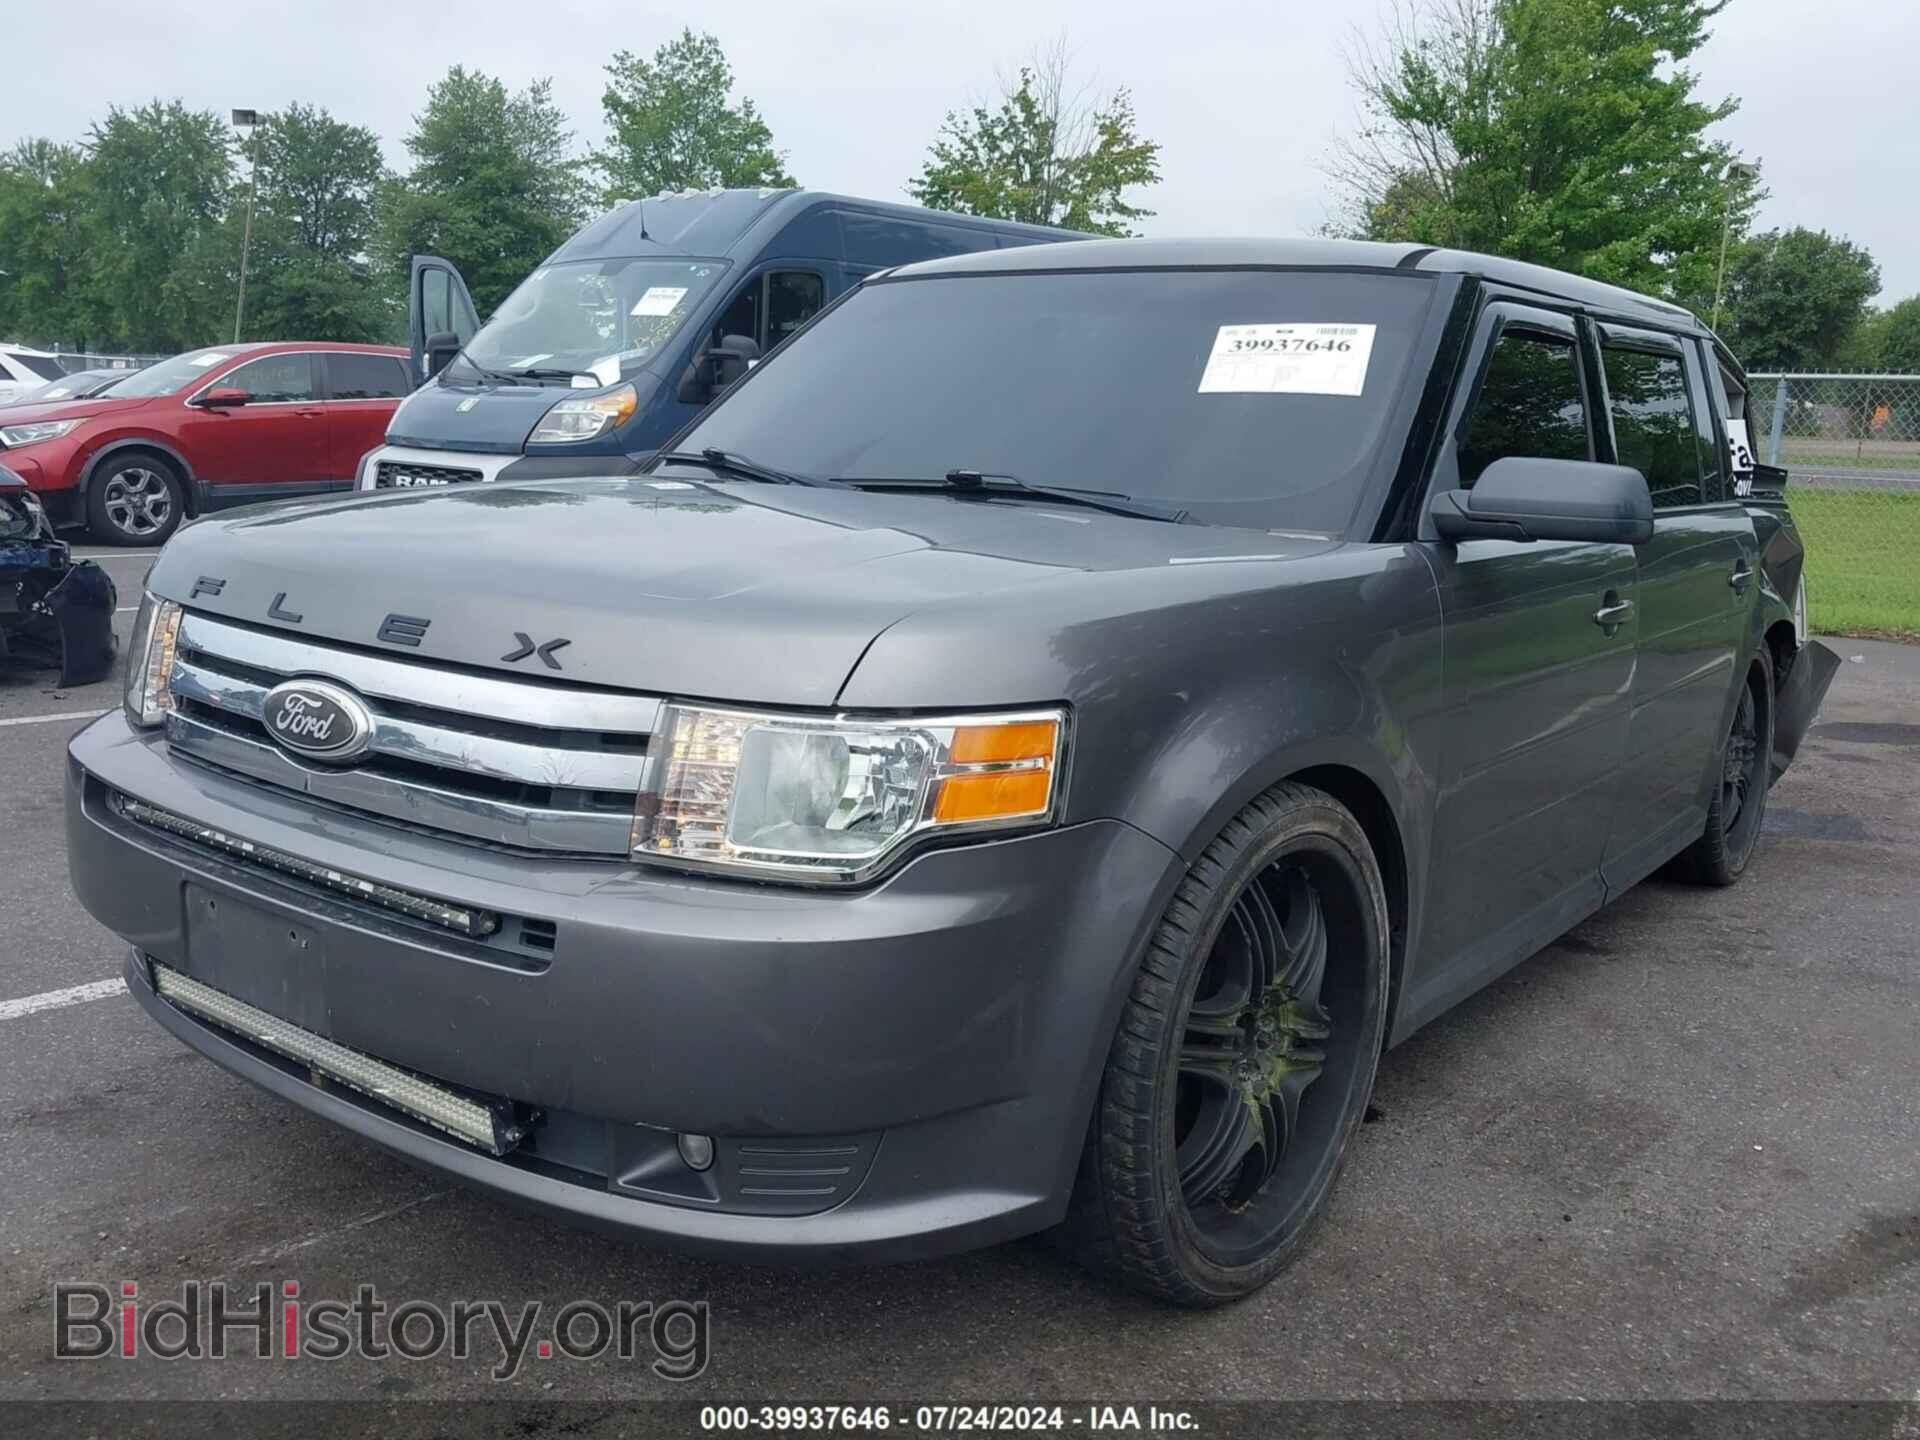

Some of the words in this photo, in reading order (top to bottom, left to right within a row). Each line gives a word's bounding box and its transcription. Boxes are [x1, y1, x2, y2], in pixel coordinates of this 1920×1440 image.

[1227, 338, 1352, 354] 39937646
[189, 575, 572, 671] FLEX
[276, 692, 336, 740] Ford
